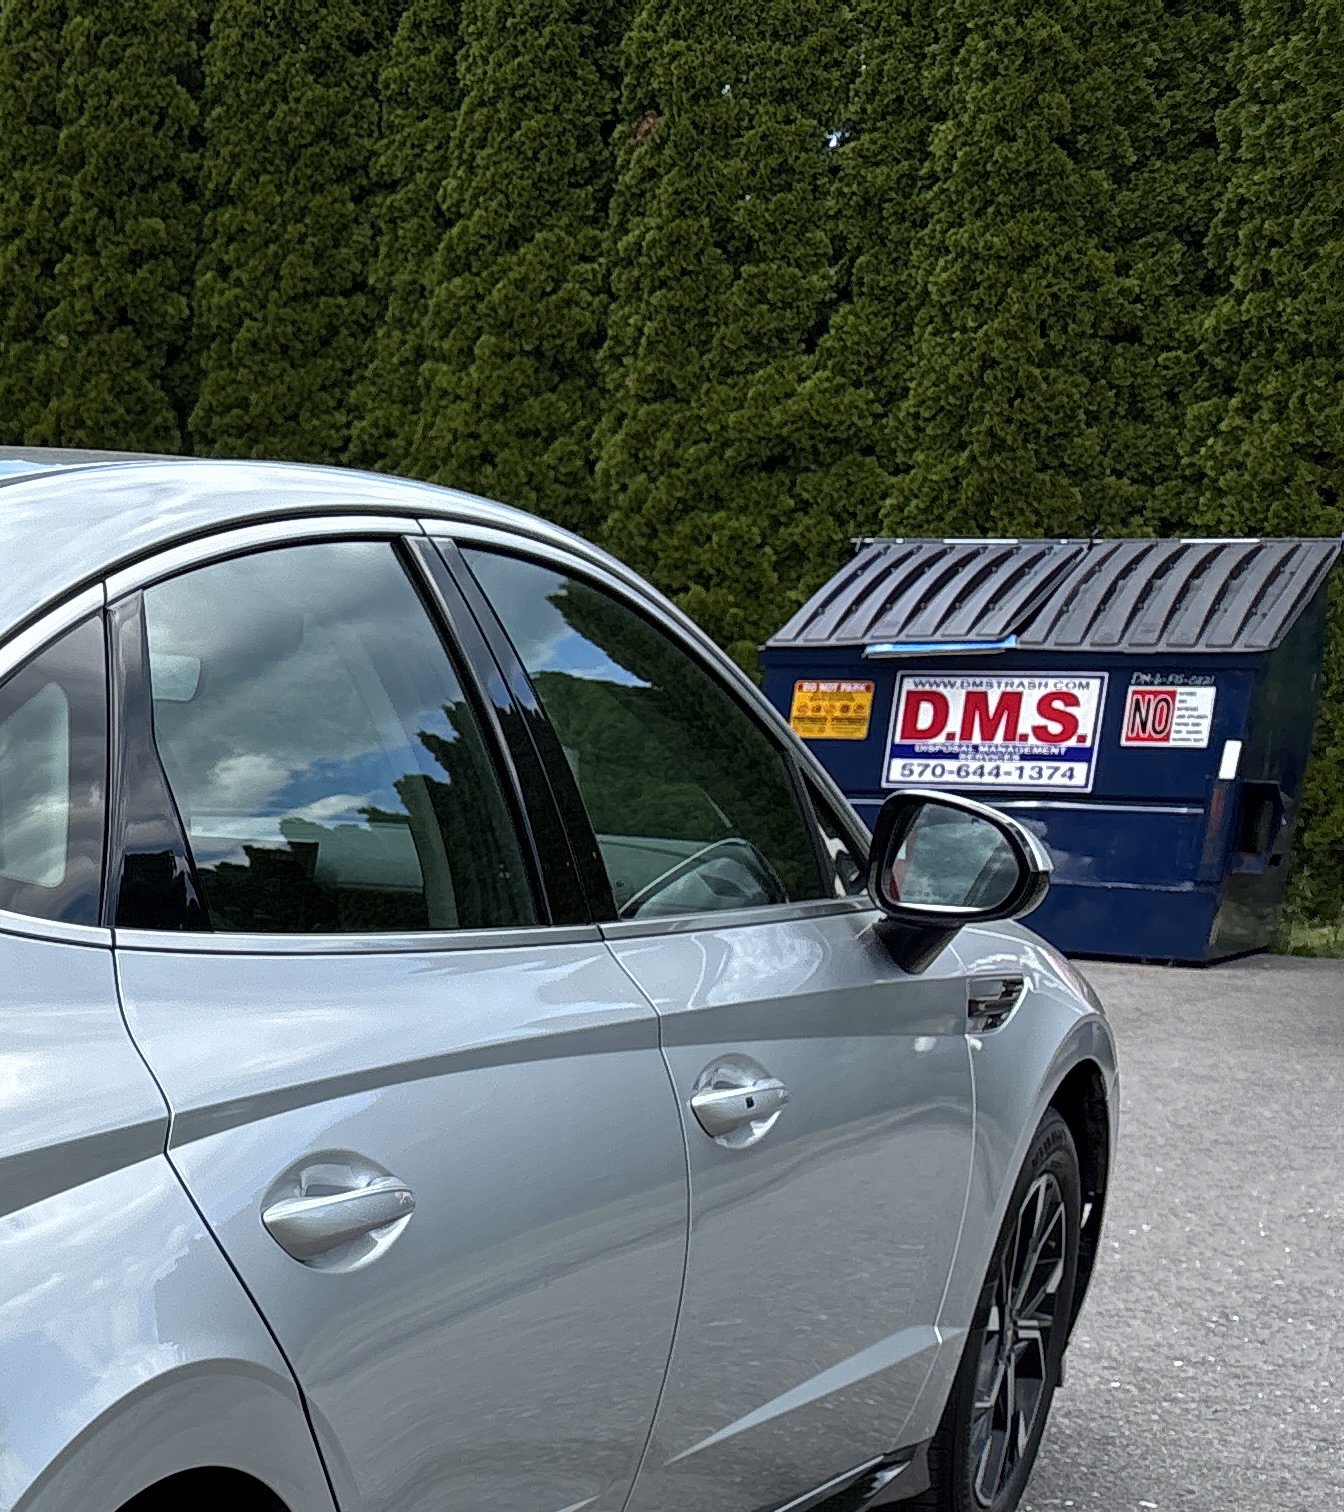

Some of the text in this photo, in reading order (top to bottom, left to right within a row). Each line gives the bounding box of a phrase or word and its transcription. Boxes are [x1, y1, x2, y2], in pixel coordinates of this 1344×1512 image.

[900, 690, 1088, 744] D.M.S.
[1128, 694, 1173, 738] NO
[900, 762, 1076, 781] 570-644-1374
